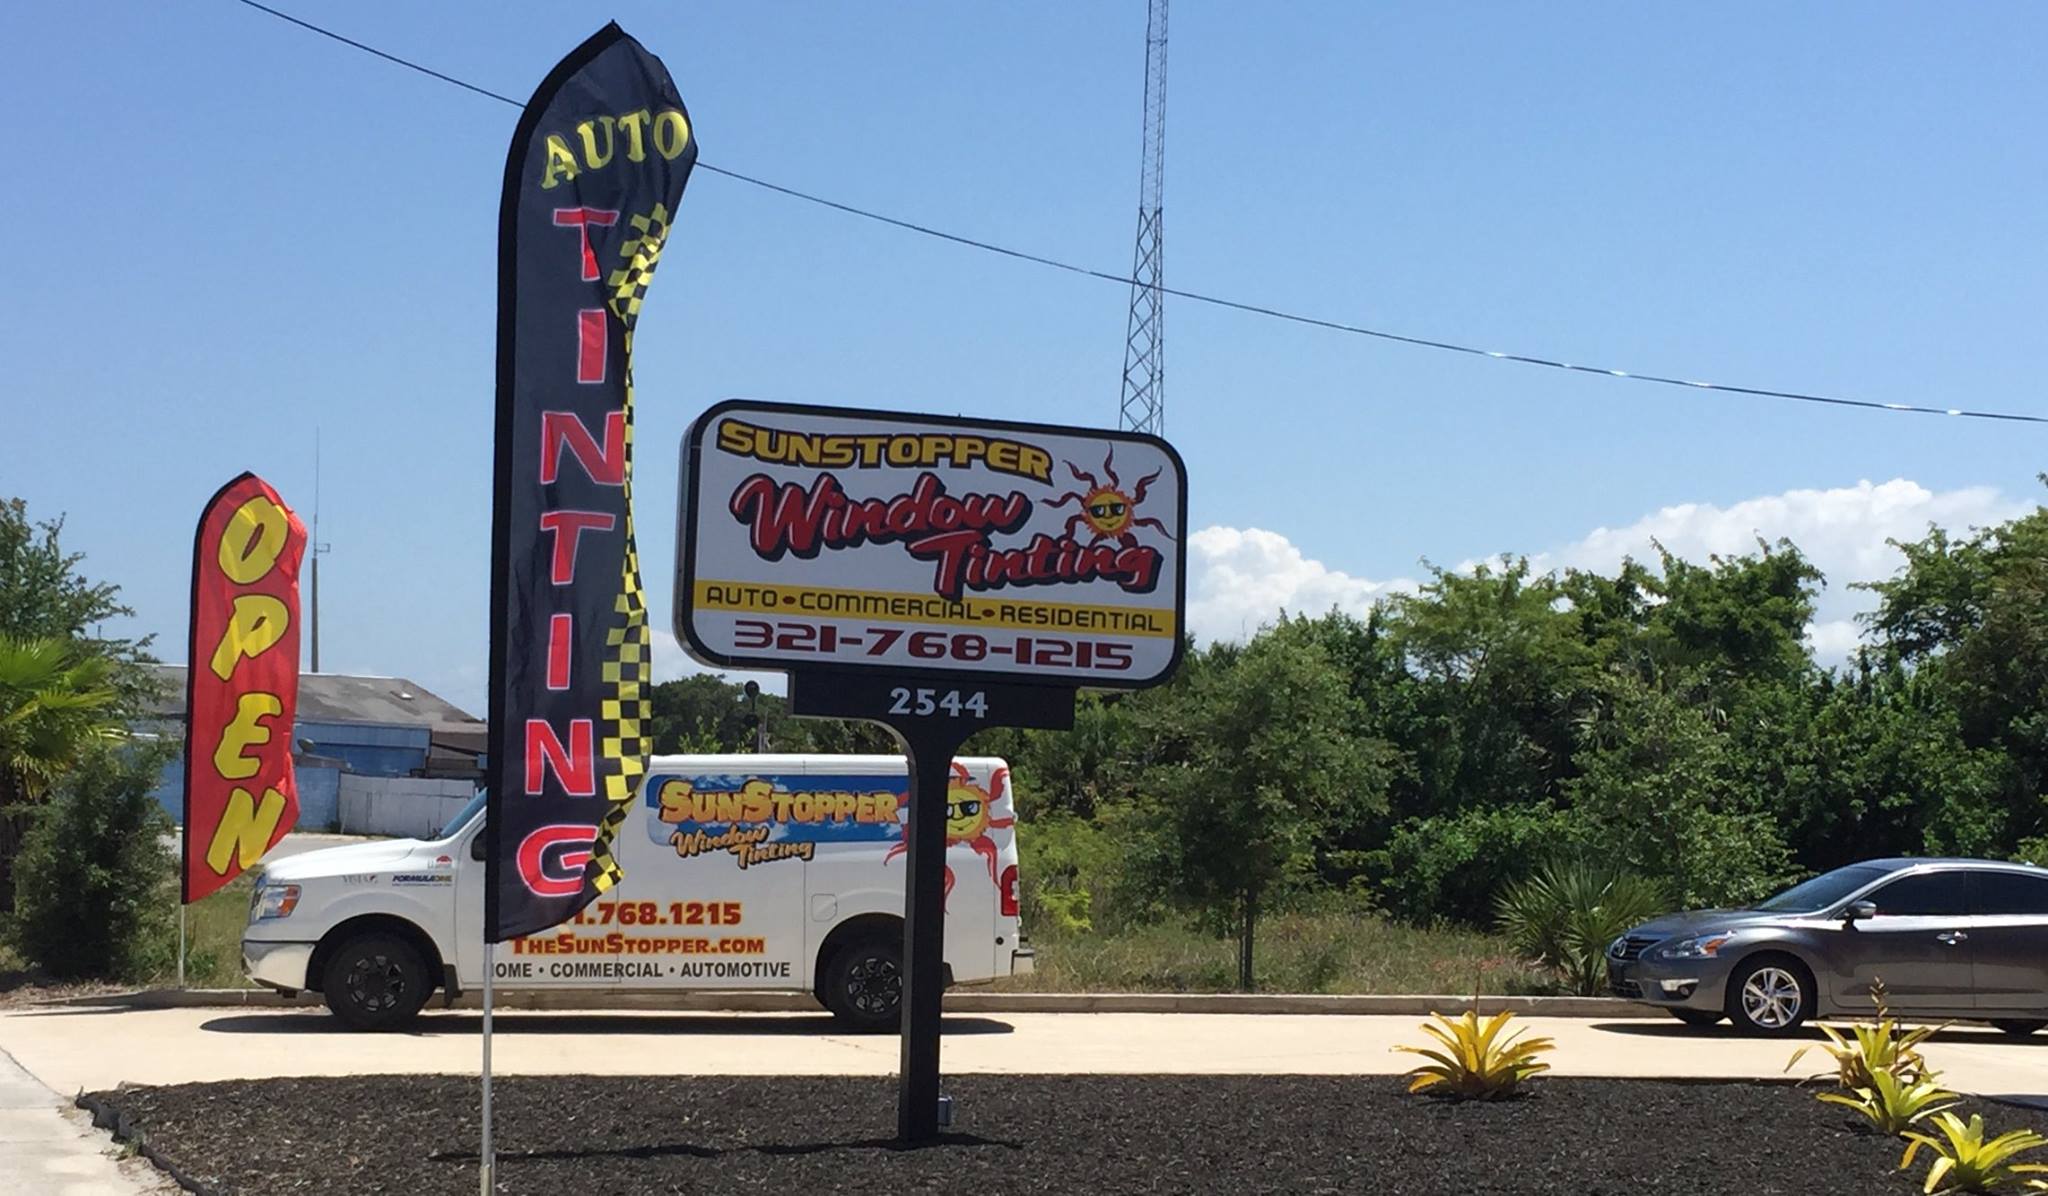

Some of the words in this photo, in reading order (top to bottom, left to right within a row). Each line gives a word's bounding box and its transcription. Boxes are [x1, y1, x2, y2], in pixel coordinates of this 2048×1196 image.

[541, 107, 690, 190] AUTO
[717, 418, 1054, 487] SUNSTOPPER
[730, 472, 1032, 561] Window
[516, 206, 625, 897] TINTING
[906, 529, 1163, 600] Tinting
[706, 586, 778, 607] AUTO
[800, 592, 982, 621] COMMERCIAL
[1001, 605, 1163, 632] RESIDENTIAL
[734, 619, 1134, 671] 321-768-1215
[205, 495, 291, 877] OPEN
[888, 687, 989, 719] 2544
[658, 779, 900, 824] SUNSTOPPER
[670, 825, 770, 858] Window
[728, 840, 816, 870] Tinting
[565, 902, 742, 925] 1.768.1215
[550, 962, 663, 978] COMMERCIAL
[680, 961, 791, 978] AUTOMOTIVE
